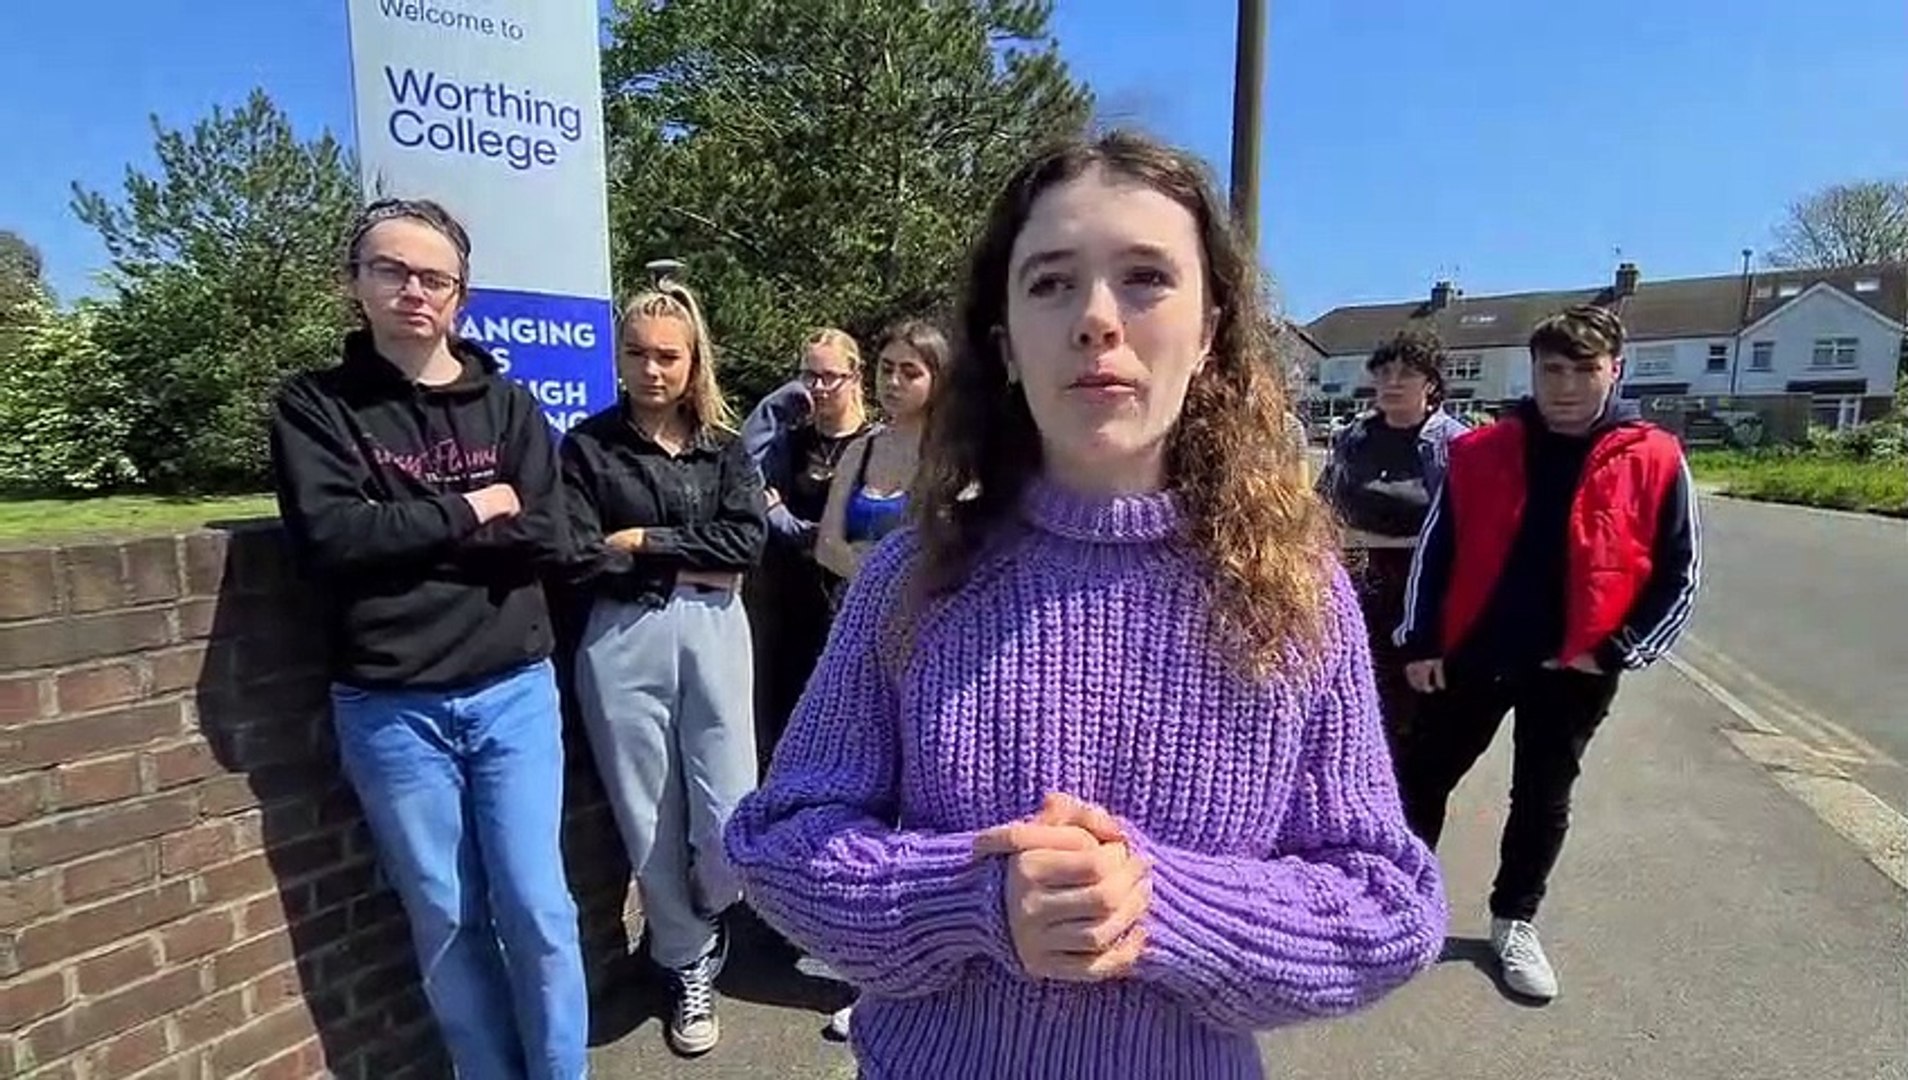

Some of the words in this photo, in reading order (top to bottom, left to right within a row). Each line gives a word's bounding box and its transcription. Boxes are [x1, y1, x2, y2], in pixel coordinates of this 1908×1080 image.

[380, 0, 494, 35] Welcome
[501, 18, 523, 40] to
[385, 65, 582, 142] Worthing
[389, 109, 558, 170] College
[460, 315, 596, 348] ANGING
[490, 347, 511, 374] S
